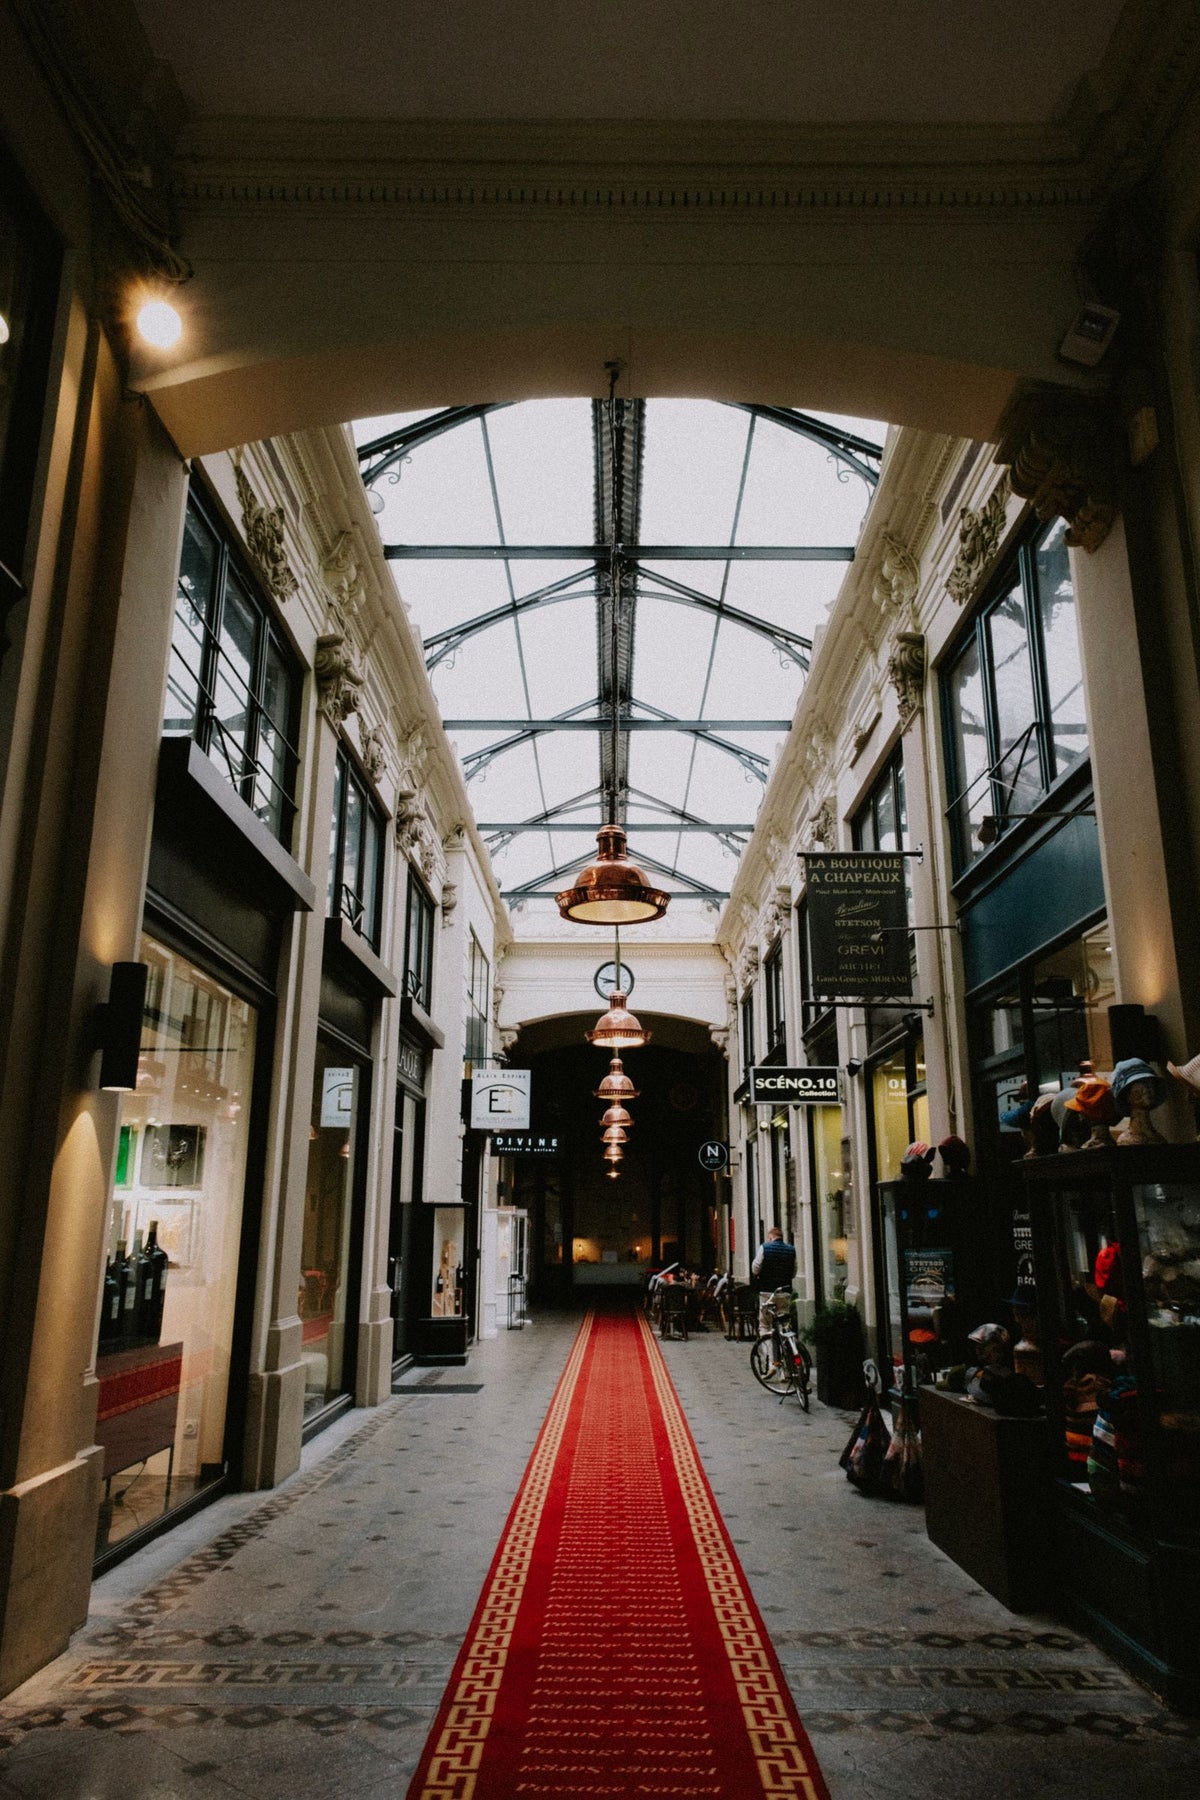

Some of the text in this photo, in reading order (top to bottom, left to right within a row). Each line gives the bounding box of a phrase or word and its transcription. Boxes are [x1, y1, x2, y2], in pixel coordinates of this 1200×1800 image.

[808, 858, 901, 870] LA BOUTIQUE
[810, 872, 900, 883] A CHAPEAUX
[834, 919, 880, 927] STETSON
[755, 1075, 836, 1089] SCÉNO.10
[496, 1137, 558, 1147] DIVINE
[707, 1145, 719, 1157] N
